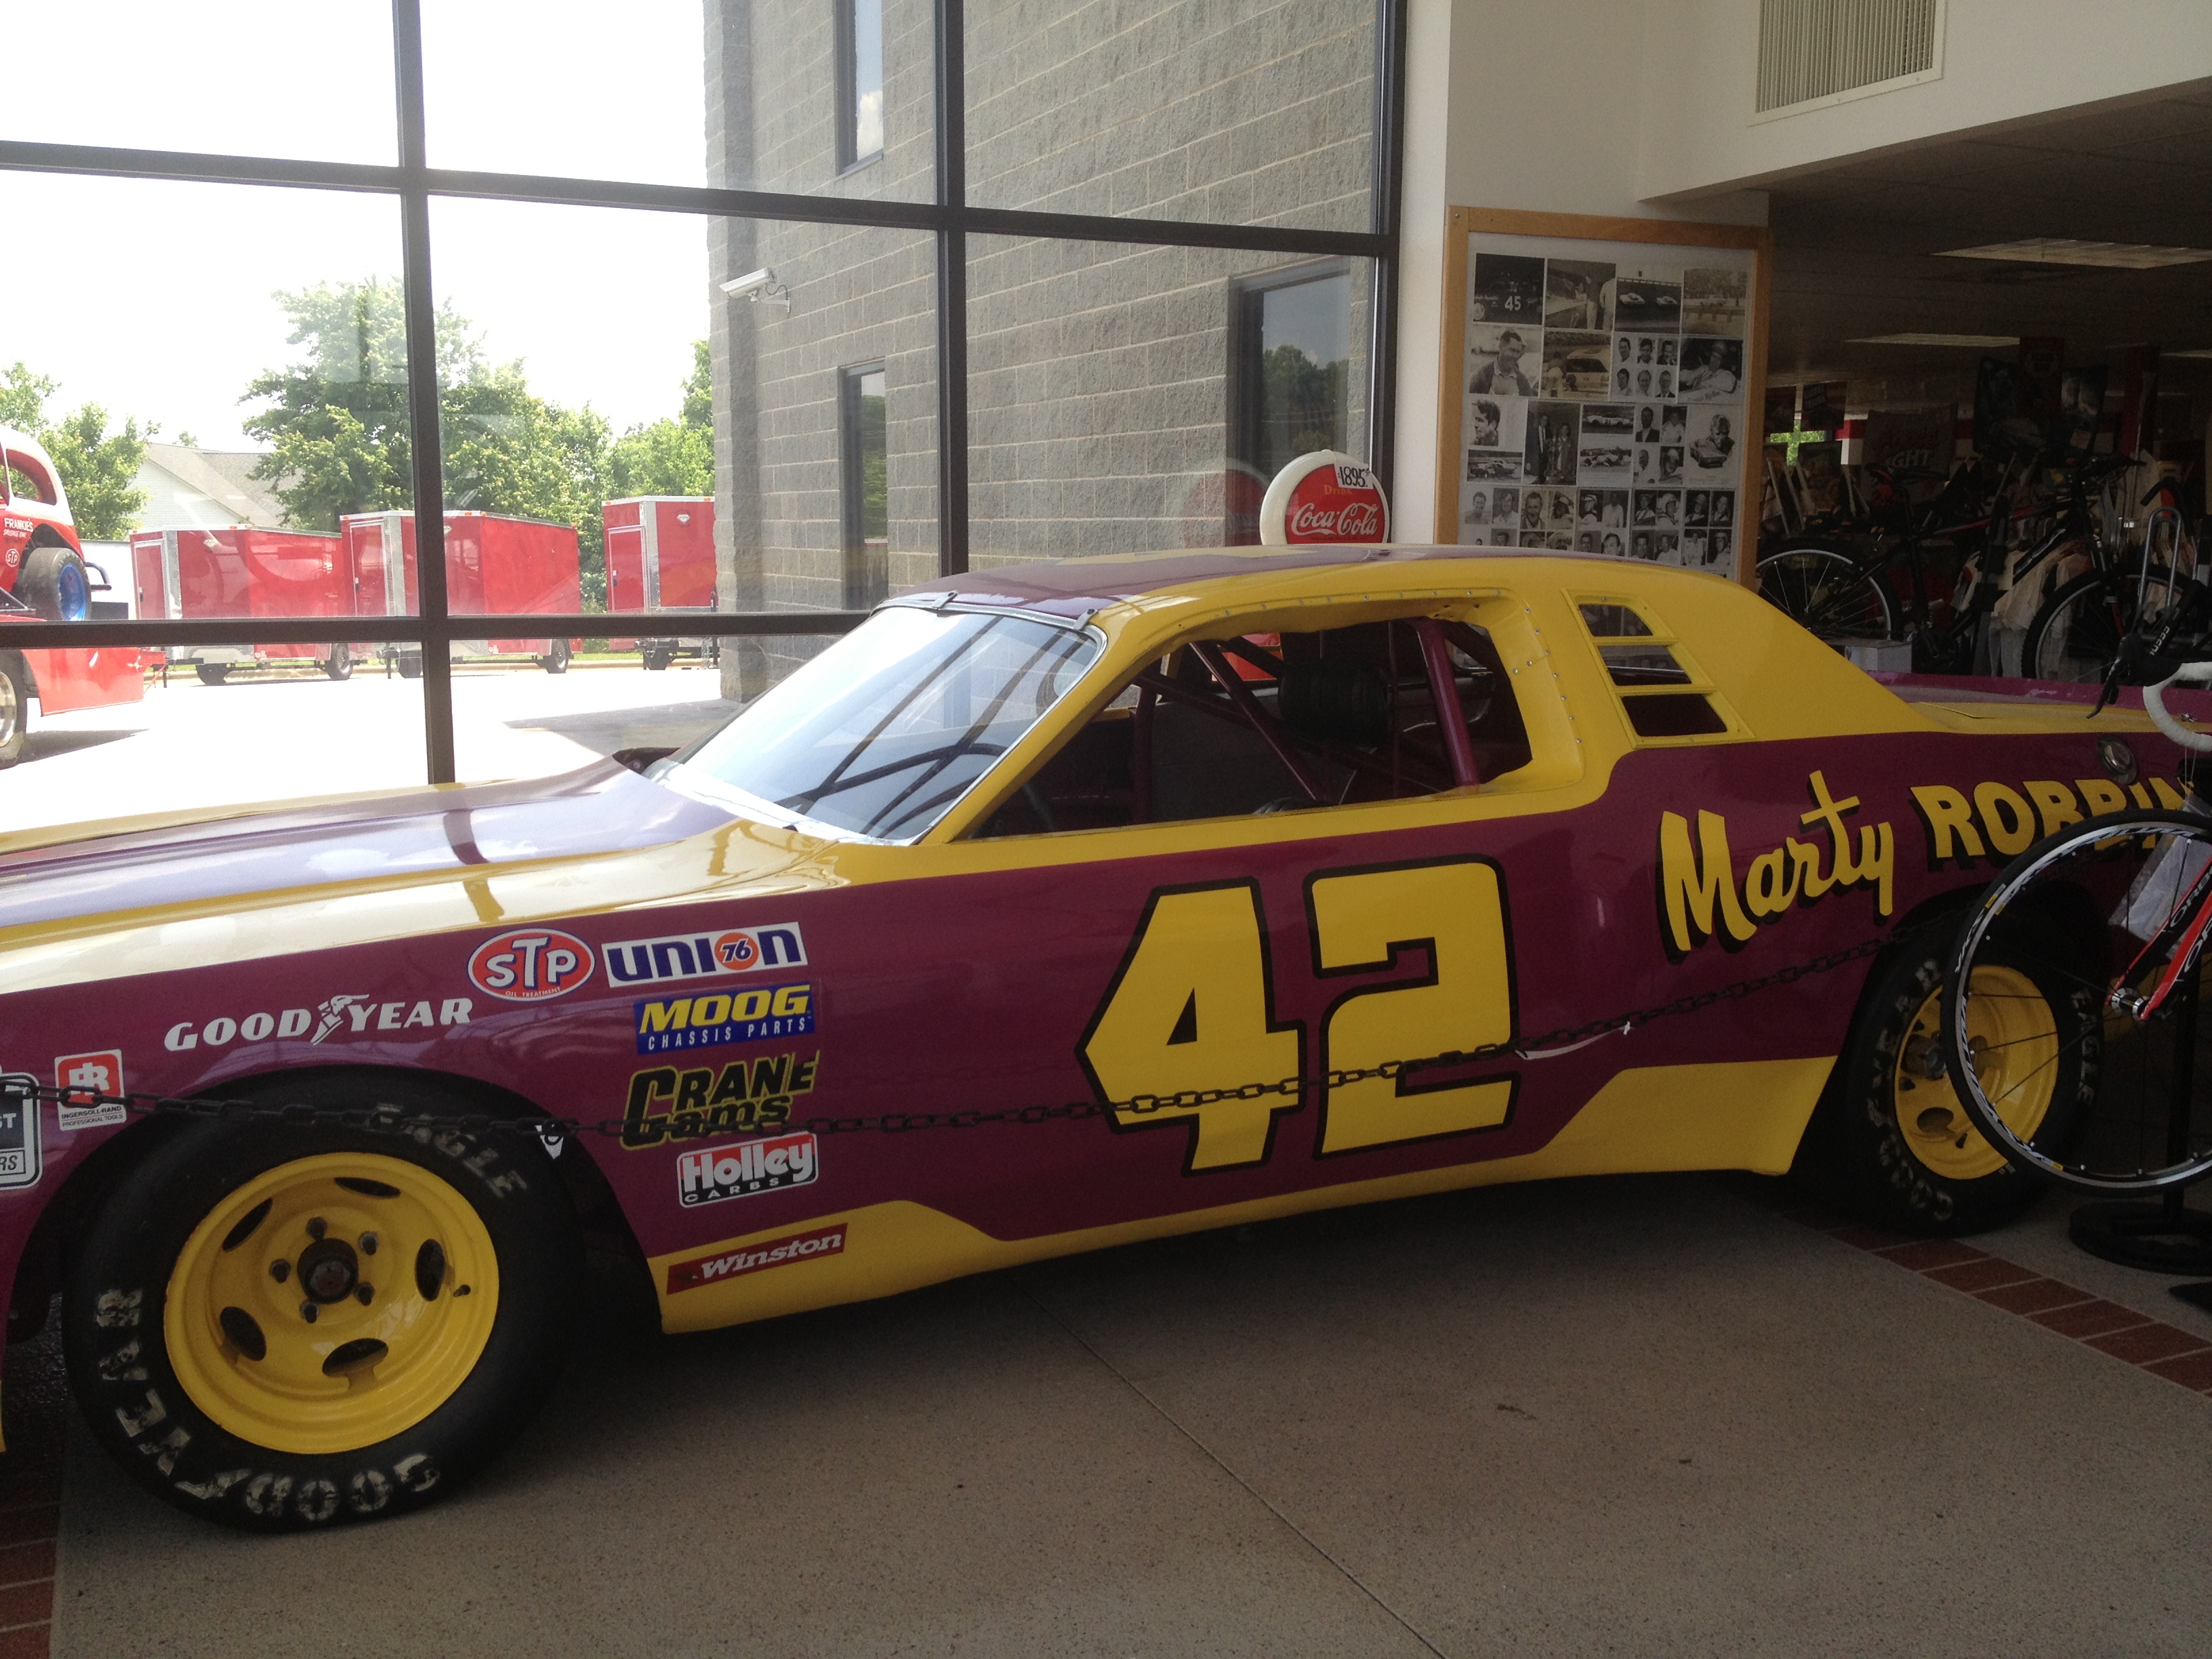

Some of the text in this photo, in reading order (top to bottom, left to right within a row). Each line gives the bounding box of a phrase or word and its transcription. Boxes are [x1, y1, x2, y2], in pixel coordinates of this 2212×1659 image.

[1504, 295, 1521, 311] 45
[1291, 503, 1380, 536] Coca-Cola
[7, 550, 18, 564] STP
[1658, 770, 1895, 954] Marty
[484, 935, 579, 988] STP
[522, 986, 562, 998] TREATMENT
[639, 984, 811, 1034] MOOG
[648, 1017, 806, 1050] CHASSIS PARTS
[1074, 853, 1521, 1176] 42
[681, 1142, 813, 1193] Holley
[684, 1177, 779, 1204] CARBS
[701, 1233, 842, 1279] Winston
